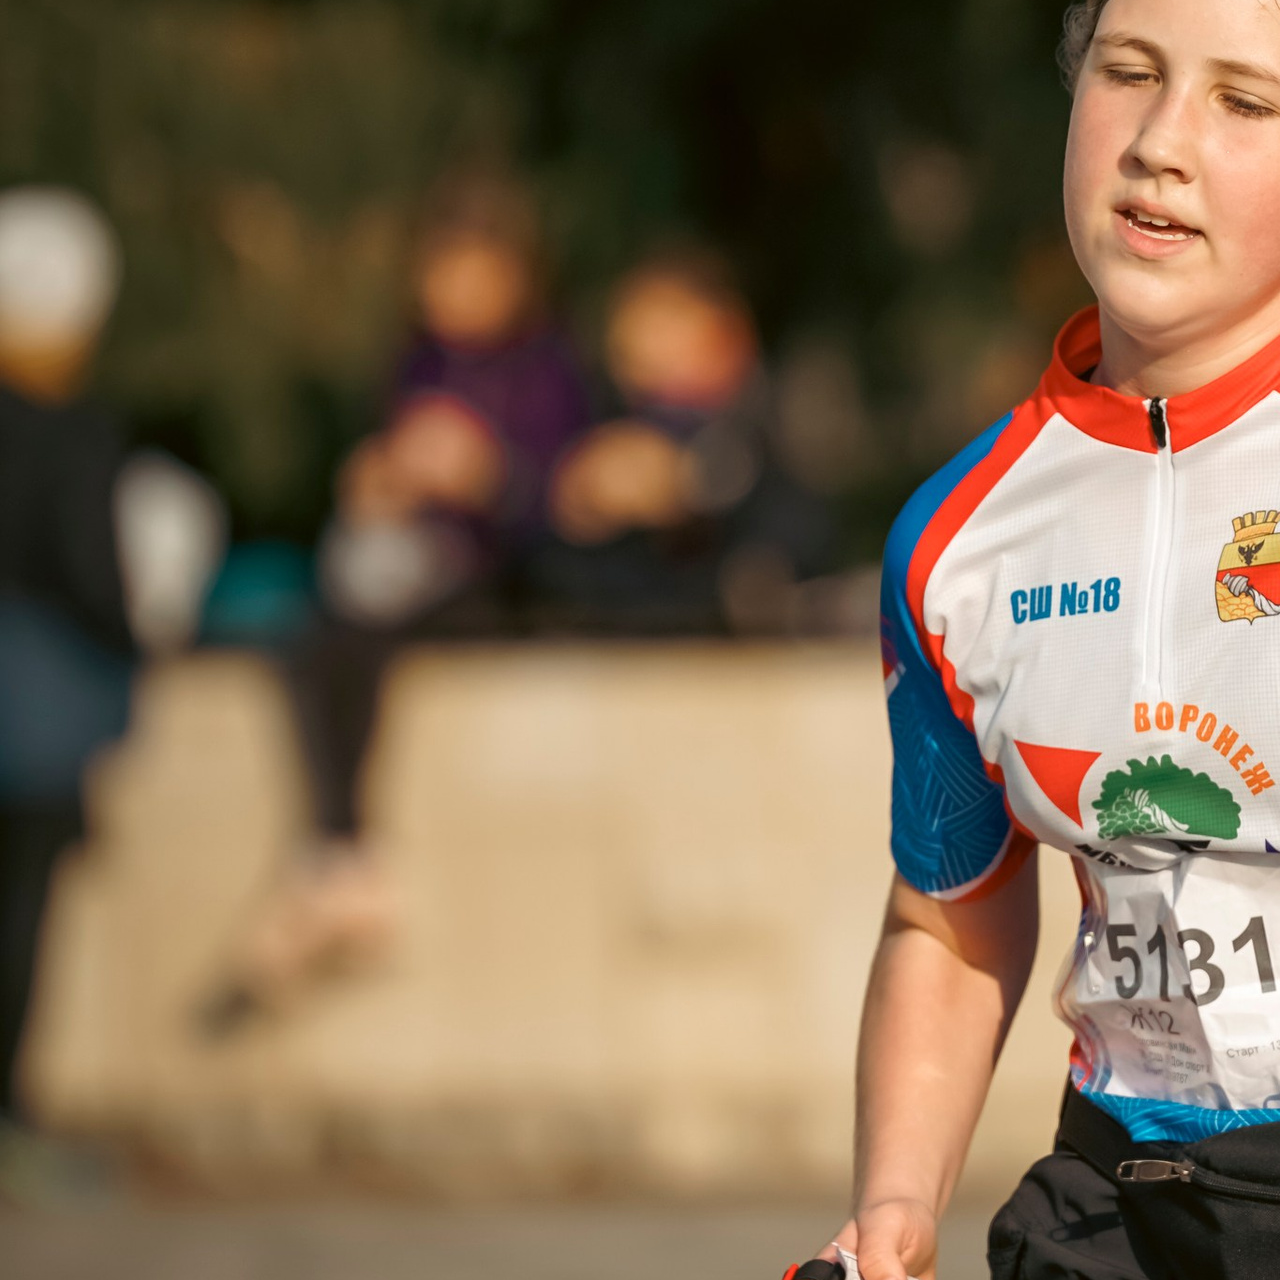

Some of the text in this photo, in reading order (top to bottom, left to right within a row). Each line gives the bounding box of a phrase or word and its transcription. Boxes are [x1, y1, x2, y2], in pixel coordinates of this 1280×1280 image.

[1010, 577, 1121, 625] СШ №18
[1134, 701, 1275, 796] ВОРОНЕЖ
[1106, 915, 1277, 1008] 5131
[1226, 1045, 1260, 1059] Старт
